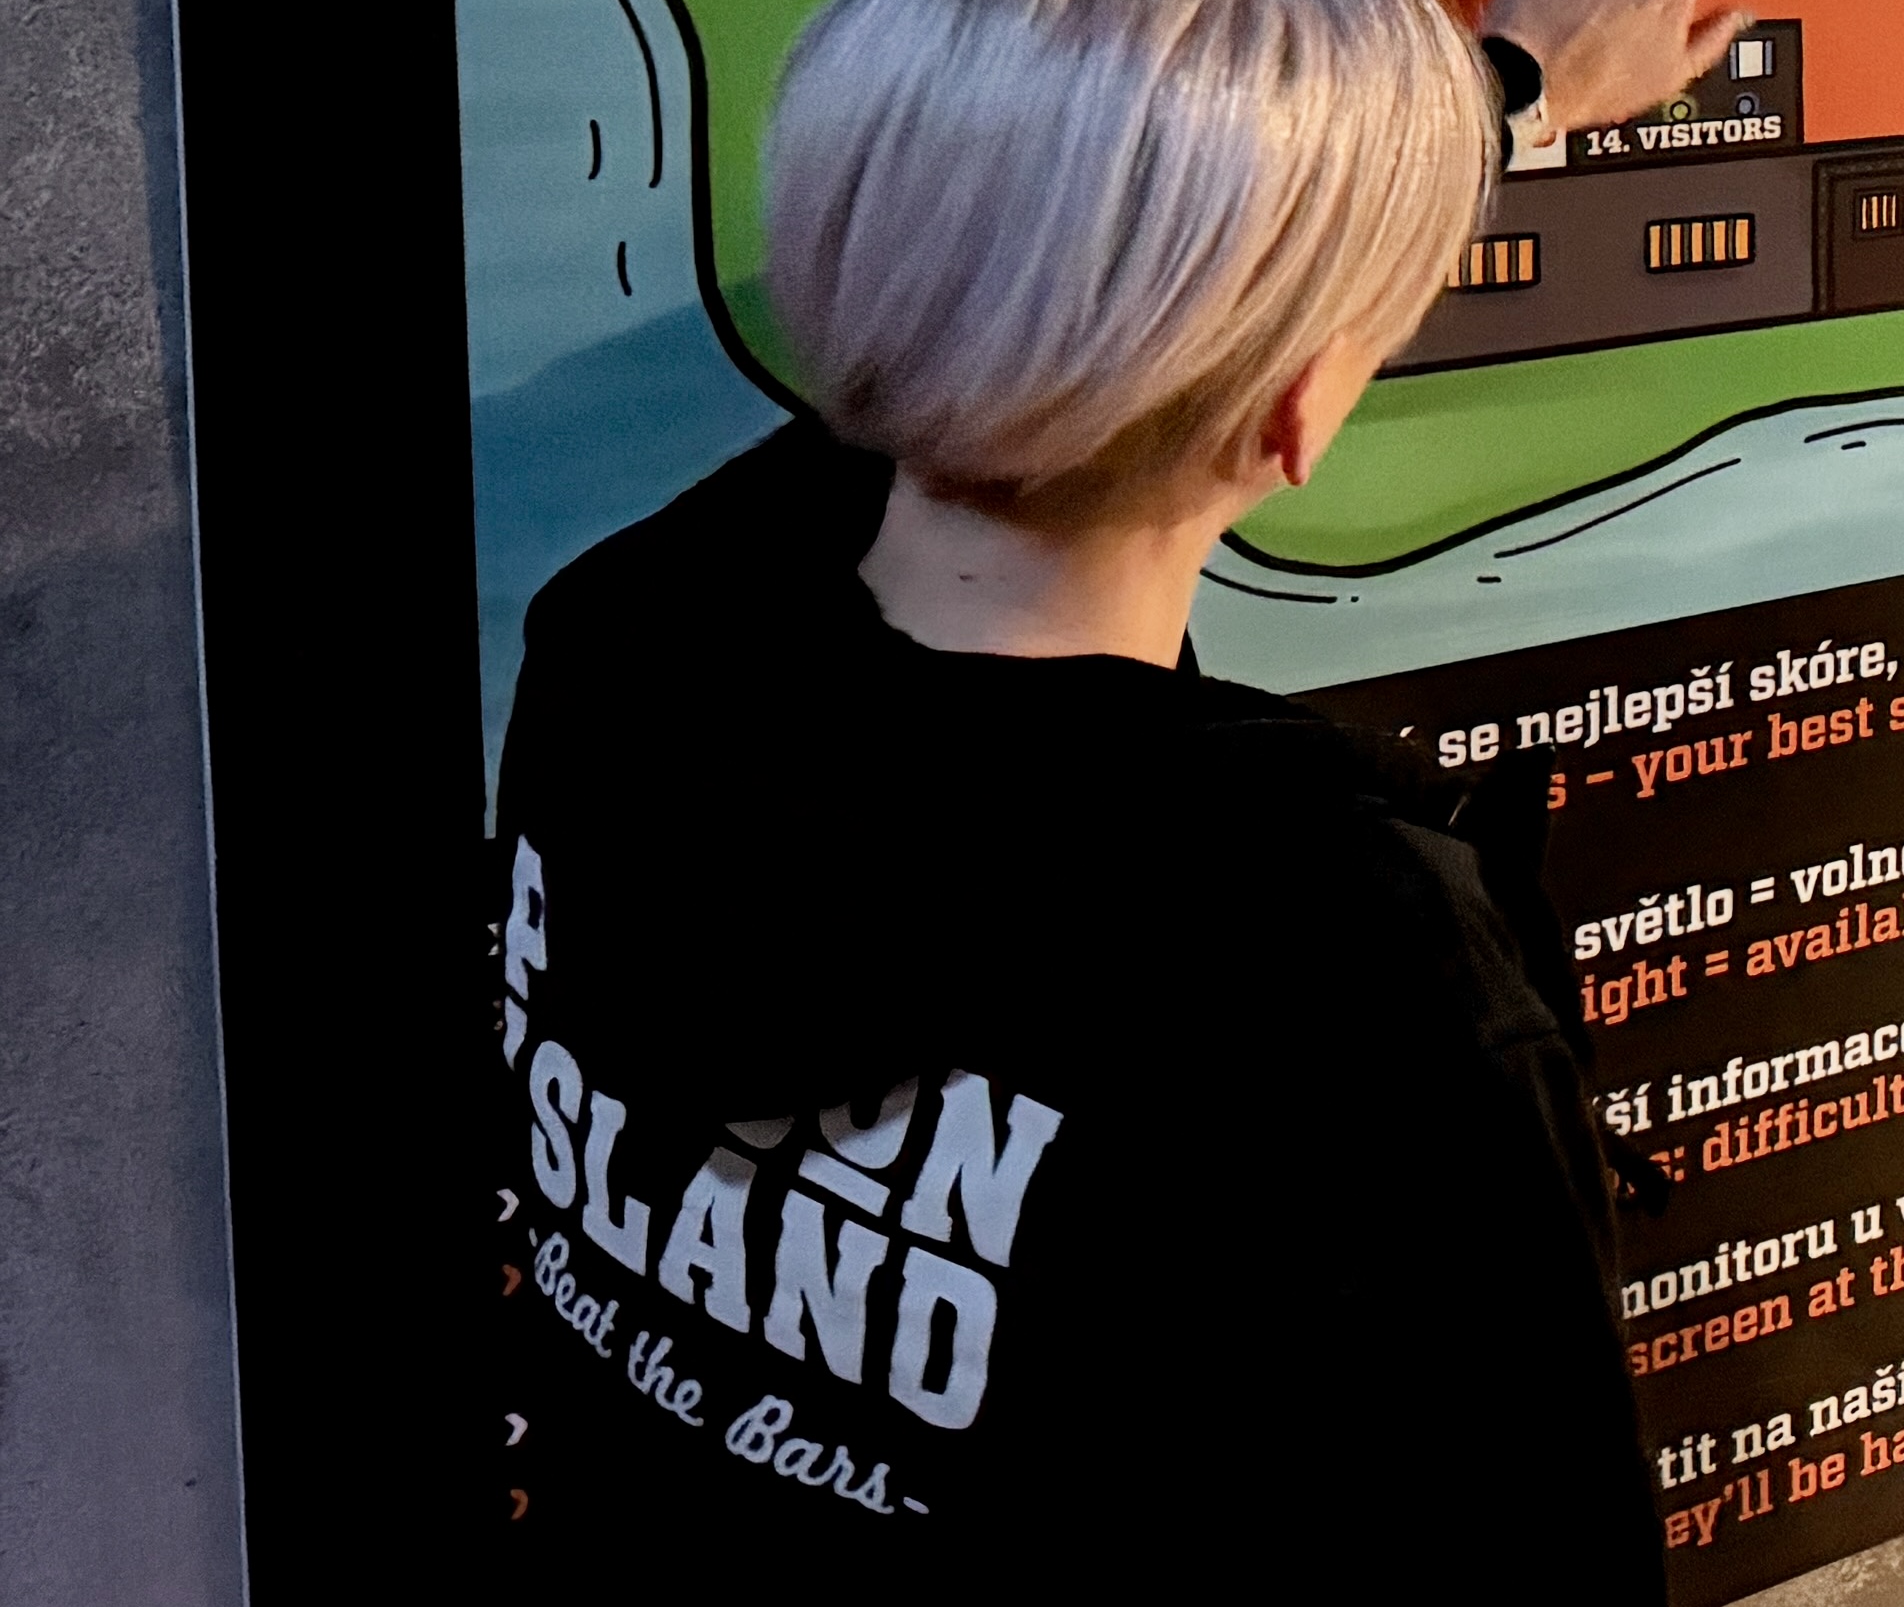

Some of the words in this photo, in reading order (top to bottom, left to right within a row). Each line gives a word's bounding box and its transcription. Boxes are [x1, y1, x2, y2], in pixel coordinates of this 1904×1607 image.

[1587, 128, 1633, 158] 14.
[1639, 115, 1783, 152] VISITORS
[1438, 723, 1500, 768] se
[1516, 661, 1734, 750] nejlepší
[1749, 639, 1898, 702] skóre,
[1631, 730, 1753, 799] your
[1767, 697, 1874, 760] best
[1574, 884, 1734, 961] světlo
[1581, 955, 1688, 1026] ight
[1850, 1204, 1884, 1244] u
[1630, 1294, 1793, 1375] screen
[1807, 1266, 1856, 1318] at
[627, 1330, 705, 1427] the
[1731, 1412, 1796, 1464] na
[1787, 1452, 1846, 1503] be
